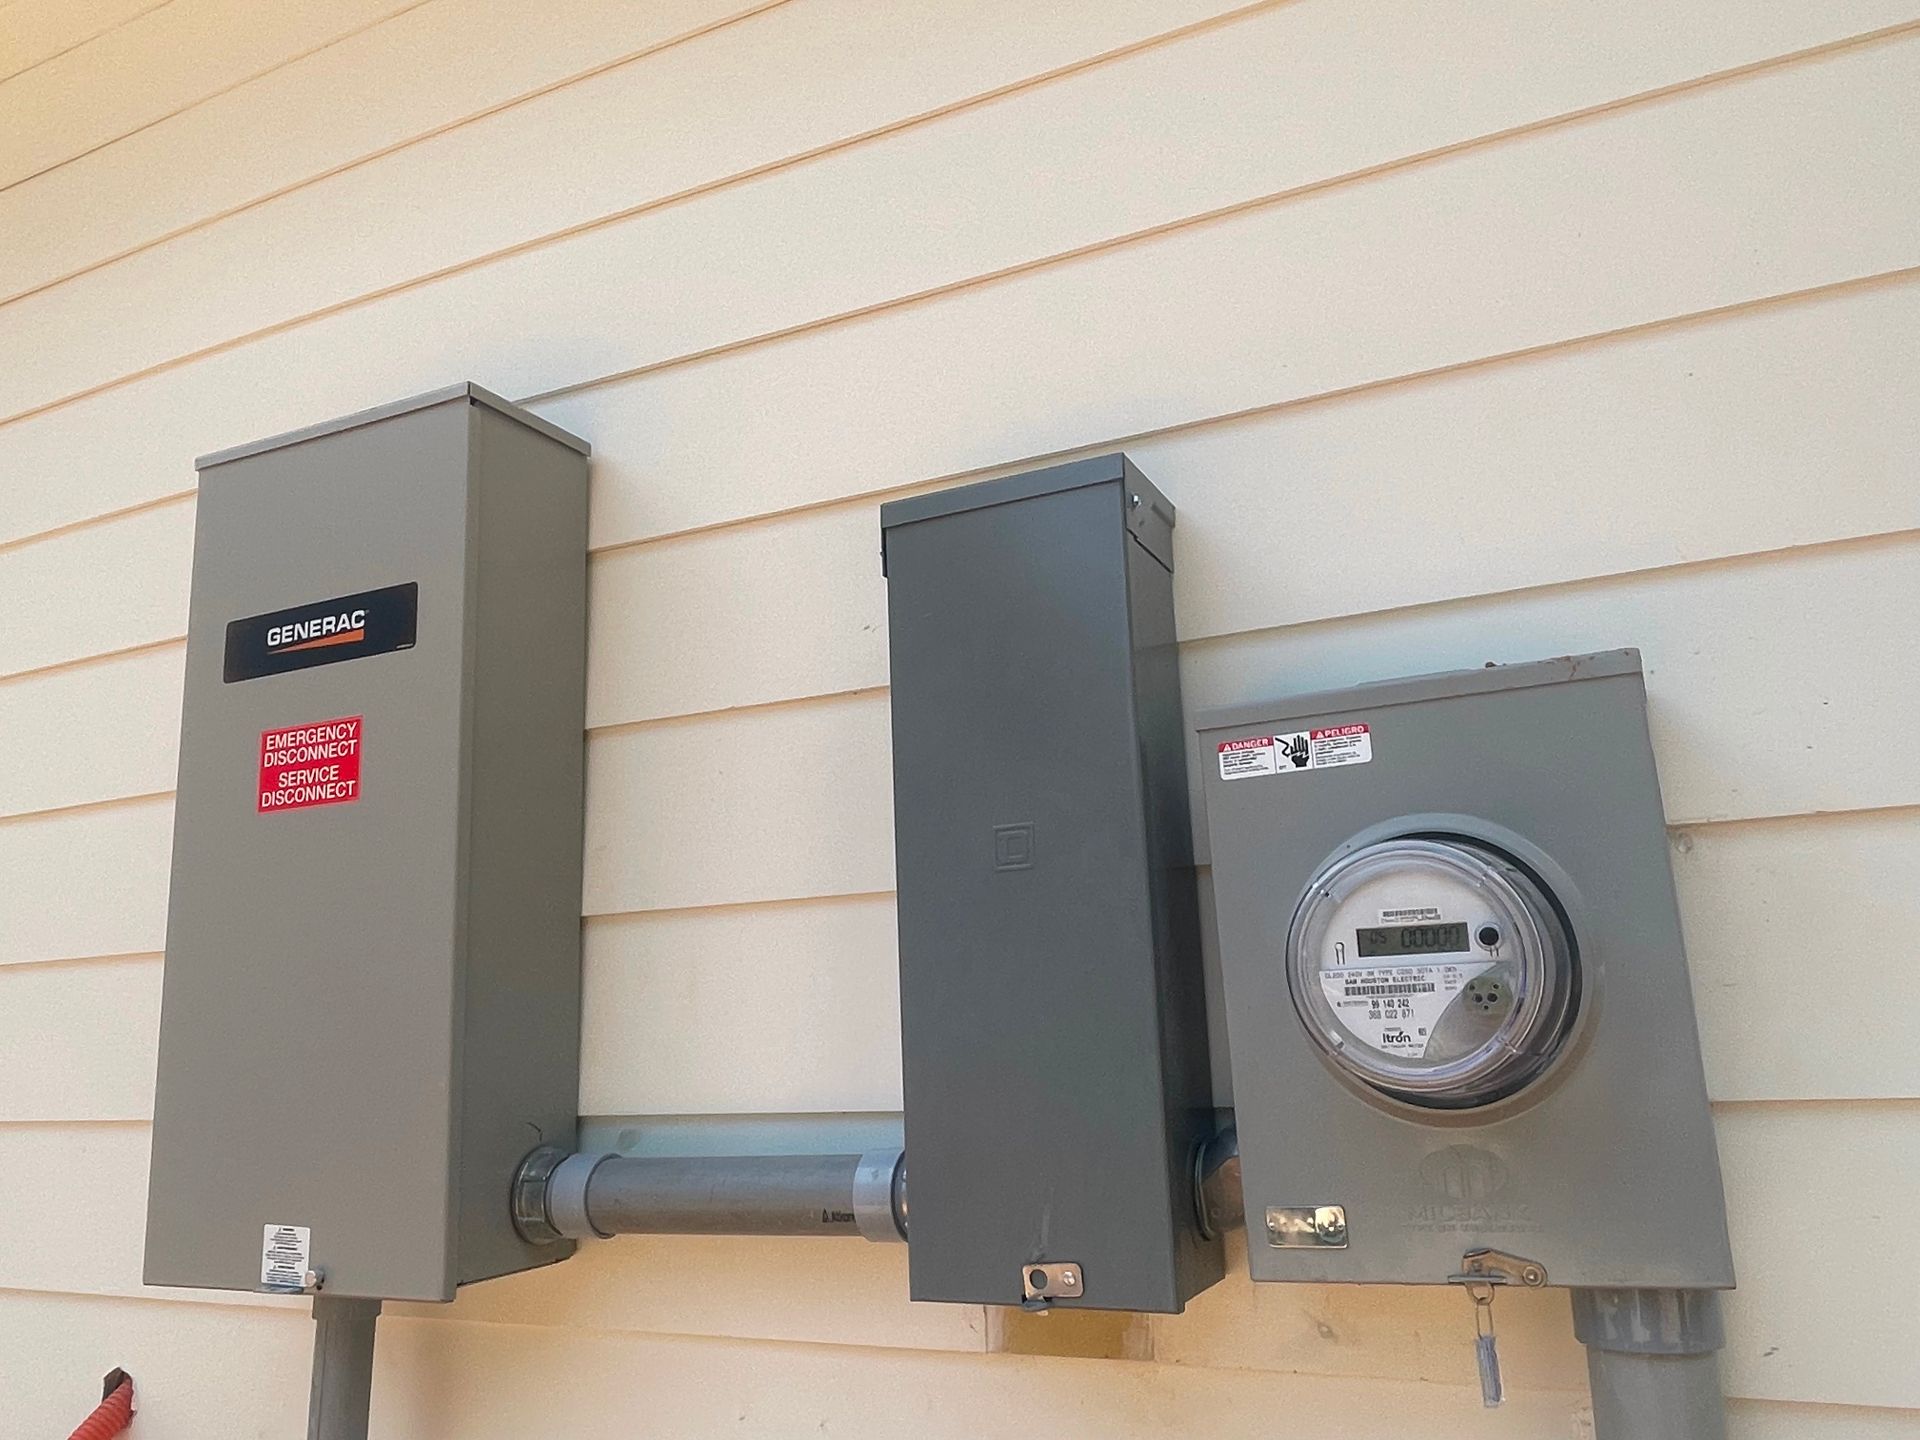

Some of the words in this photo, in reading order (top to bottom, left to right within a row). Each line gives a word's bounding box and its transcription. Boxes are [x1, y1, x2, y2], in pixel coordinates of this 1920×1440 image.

[267, 610, 366, 646] GENERAC
[266, 722, 357, 751] EMERGENCY
[1325, 725, 1365, 738] PELIGRO
[264, 739, 358, 767] DISCONNECT
[1232, 738, 1269, 751] DANGER
[278, 764, 340, 788] SERVICE
[261, 780, 356, 807] DISCONNECT
[1392, 975, 1425, 983] ELECTRIC
[1382, 1031, 1411, 1043] Itron
